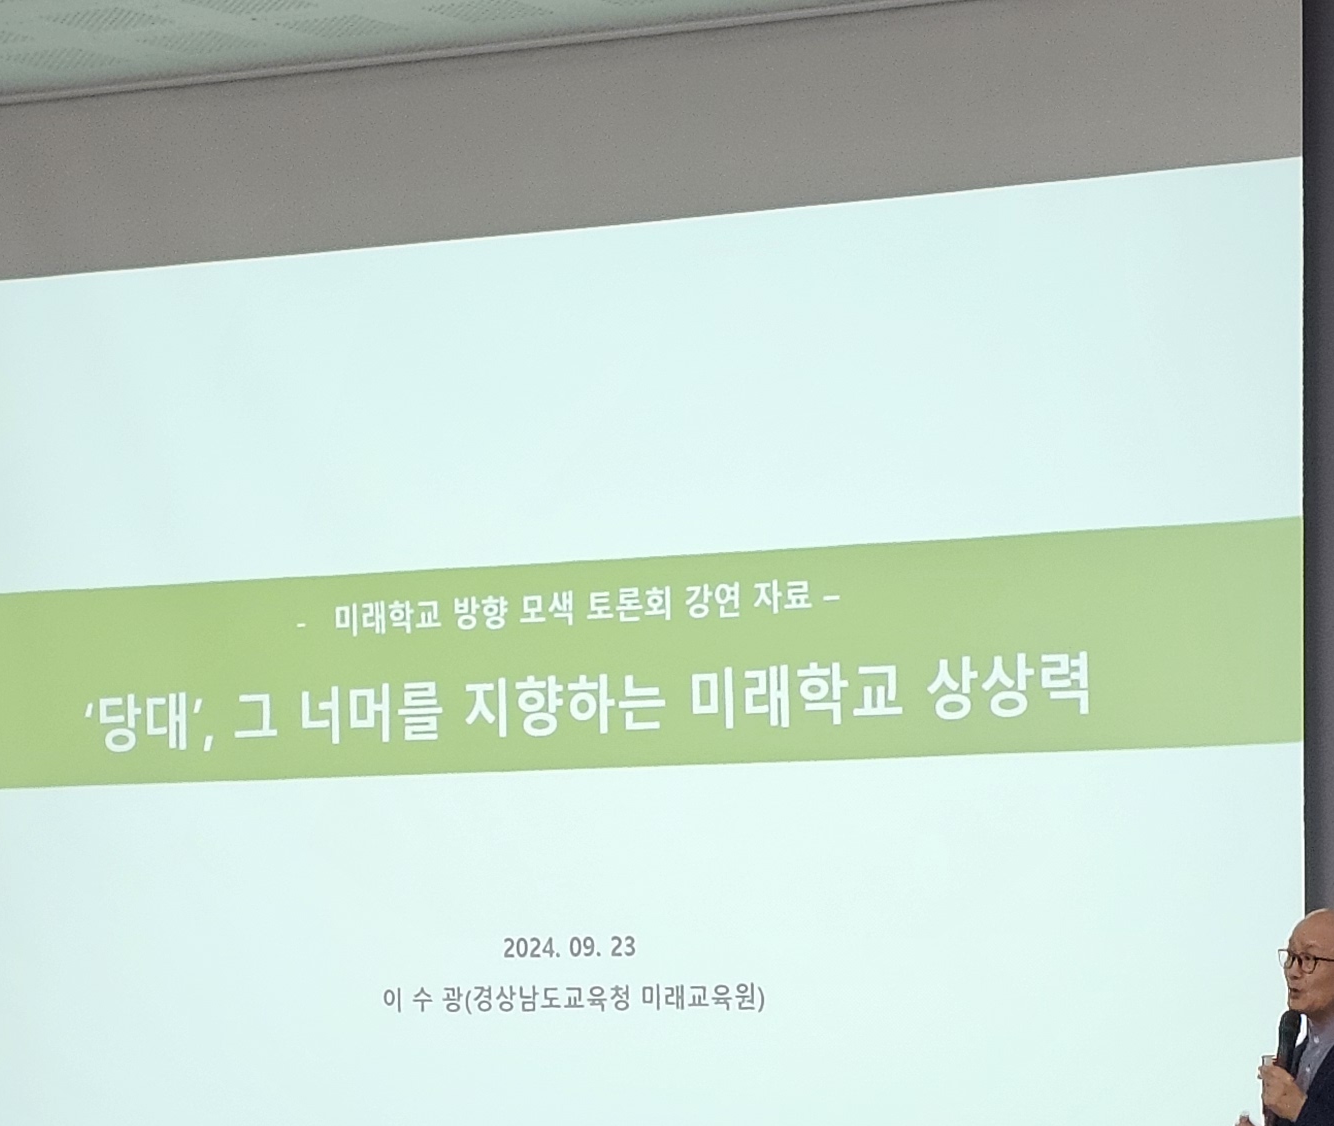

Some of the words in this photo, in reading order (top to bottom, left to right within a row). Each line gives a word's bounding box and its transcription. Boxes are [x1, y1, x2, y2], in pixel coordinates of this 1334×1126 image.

[335, 600, 442, 637] 미래학교
[453, 595, 509, 630] 방향
[519, 590, 574, 626] 모색
[586, 585, 671, 622] 토론회
[685, 581, 741, 619] 강연
[753, 578, 813, 615] 자료
[234, 693, 278, 739] 그
[301, 681, 443, 745] 너머를
[465, 673, 666, 738] 지향하는
[691, 661, 903, 730] 미래학교
[926, 650, 1090, 720] 상상력
[503, 937, 561, 958] 2024.
[569, 937, 602, 958] 09.
[611, 936, 636, 957] 23
[641, 982, 766, 1013] 미래교육원)
